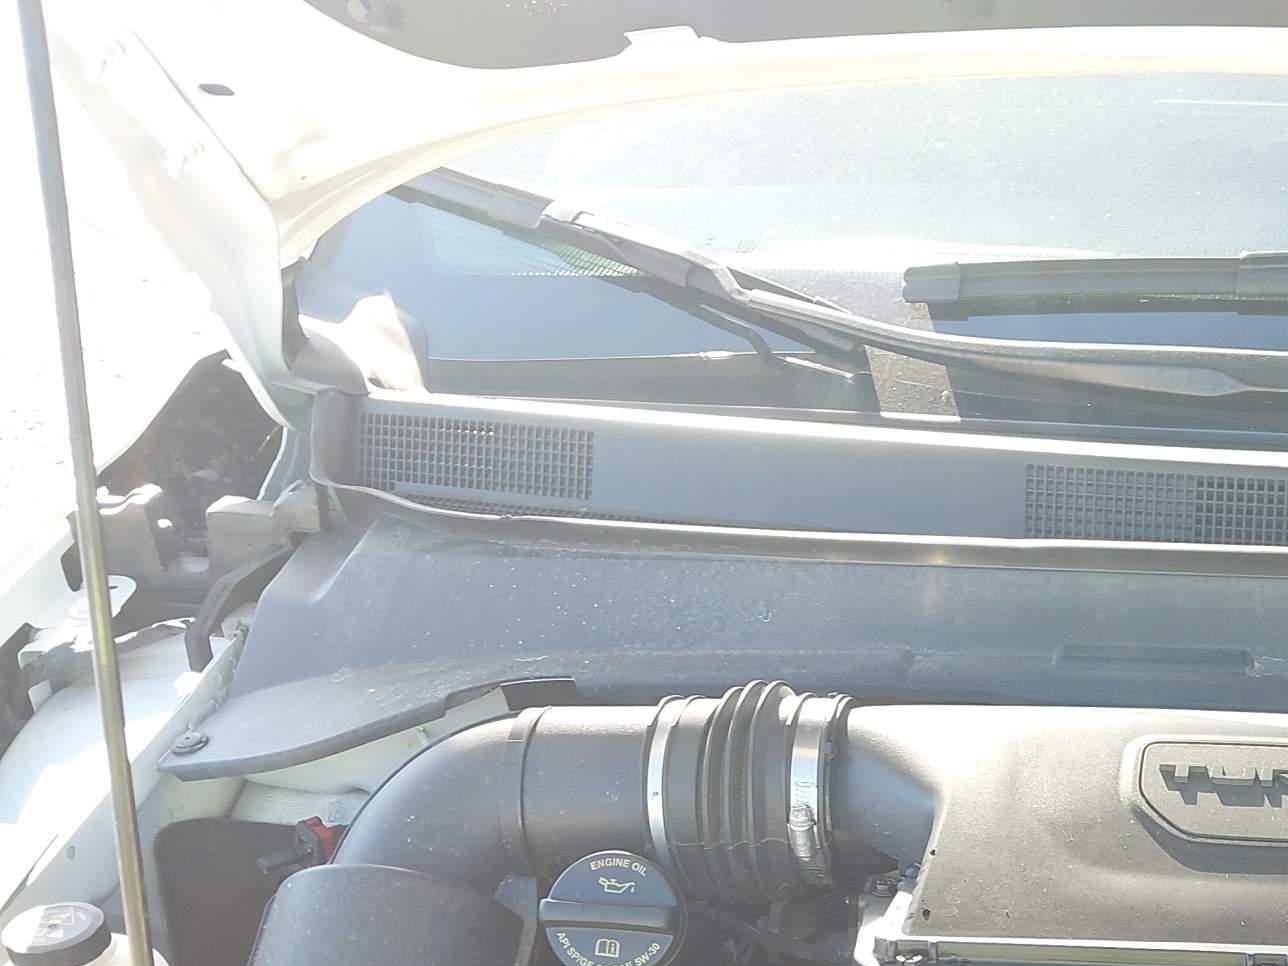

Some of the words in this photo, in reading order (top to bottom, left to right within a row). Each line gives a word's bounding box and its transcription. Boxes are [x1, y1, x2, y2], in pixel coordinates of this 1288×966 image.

[590, 857, 630, 871] ENGINE
[631, 859, 648, 877] OIL
[556, 931, 570, 949] API
[634, 942, 661, 966] 5W-30
